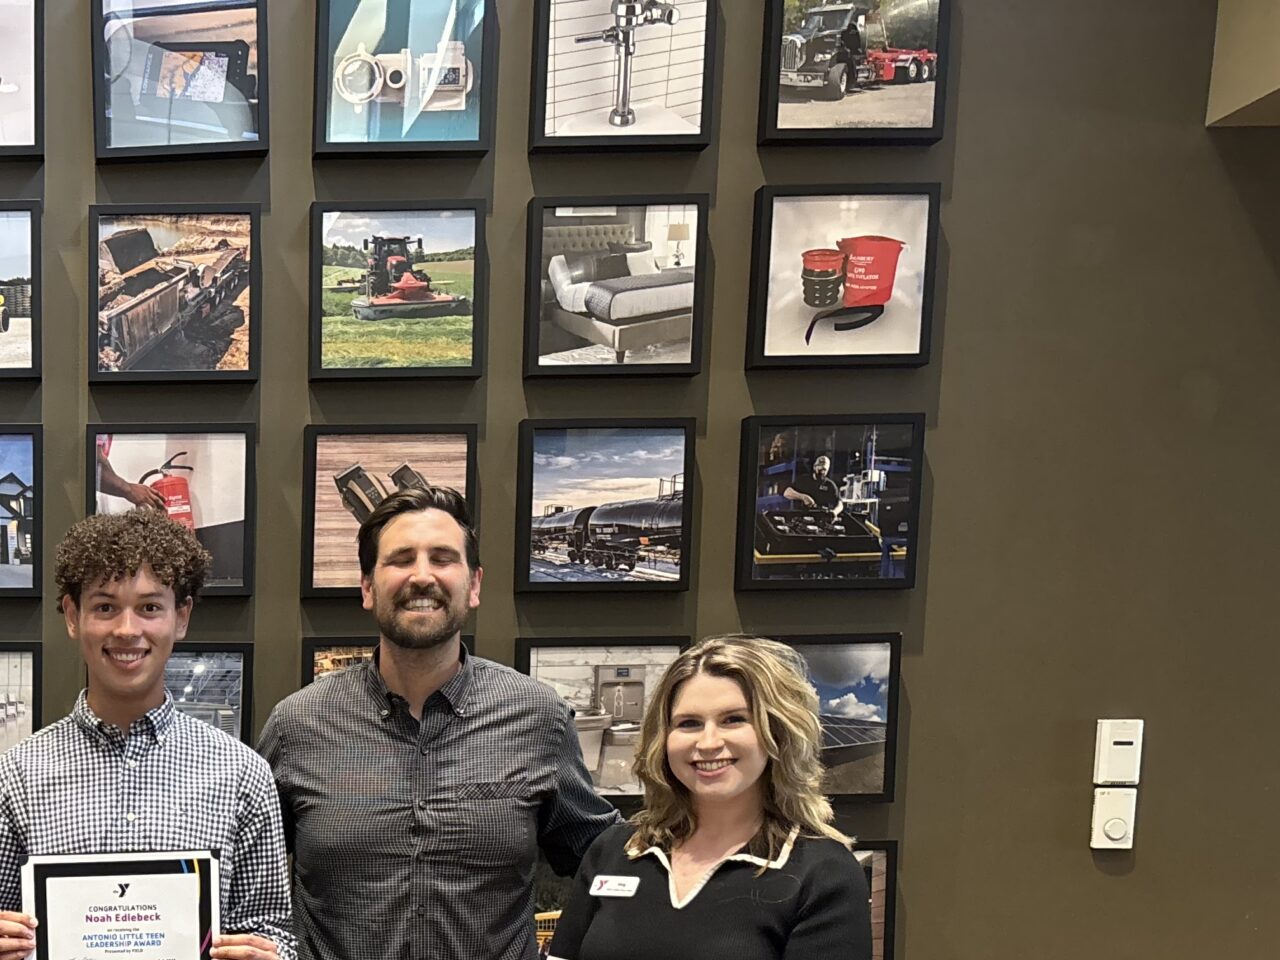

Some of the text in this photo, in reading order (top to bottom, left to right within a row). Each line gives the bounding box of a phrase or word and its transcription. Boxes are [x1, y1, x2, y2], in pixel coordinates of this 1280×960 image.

[88, 904, 158, 912] CONGRATULATIONS
[85, 913, 112, 923] Noah
[82, 933, 118, 941] ANTONIO
[145, 932, 166, 940] TEEN
[86, 939, 162, 948] LEADERSHIP AWARD
